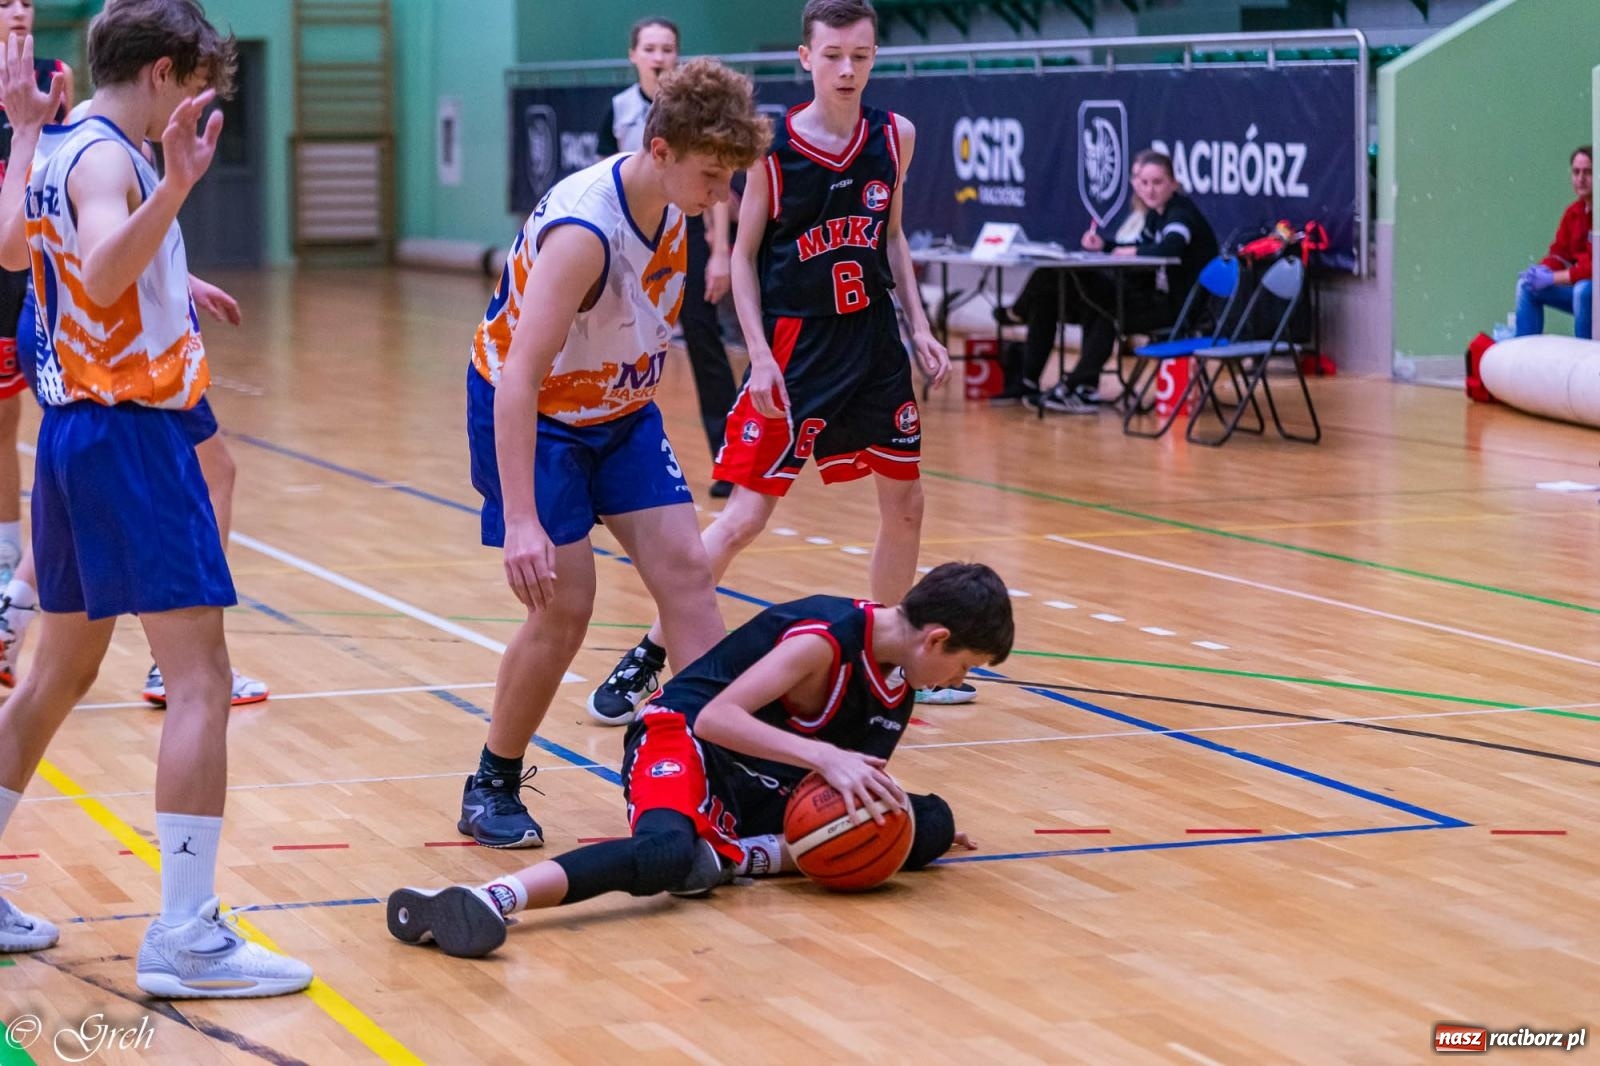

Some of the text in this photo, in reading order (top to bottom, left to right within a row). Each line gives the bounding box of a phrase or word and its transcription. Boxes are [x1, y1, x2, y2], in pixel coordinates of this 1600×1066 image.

[832, 260, 870, 315] 6
[965, 342, 991, 385] 5
[1155, 358, 1176, 401] 5
[661, 438, 683, 479] 3
